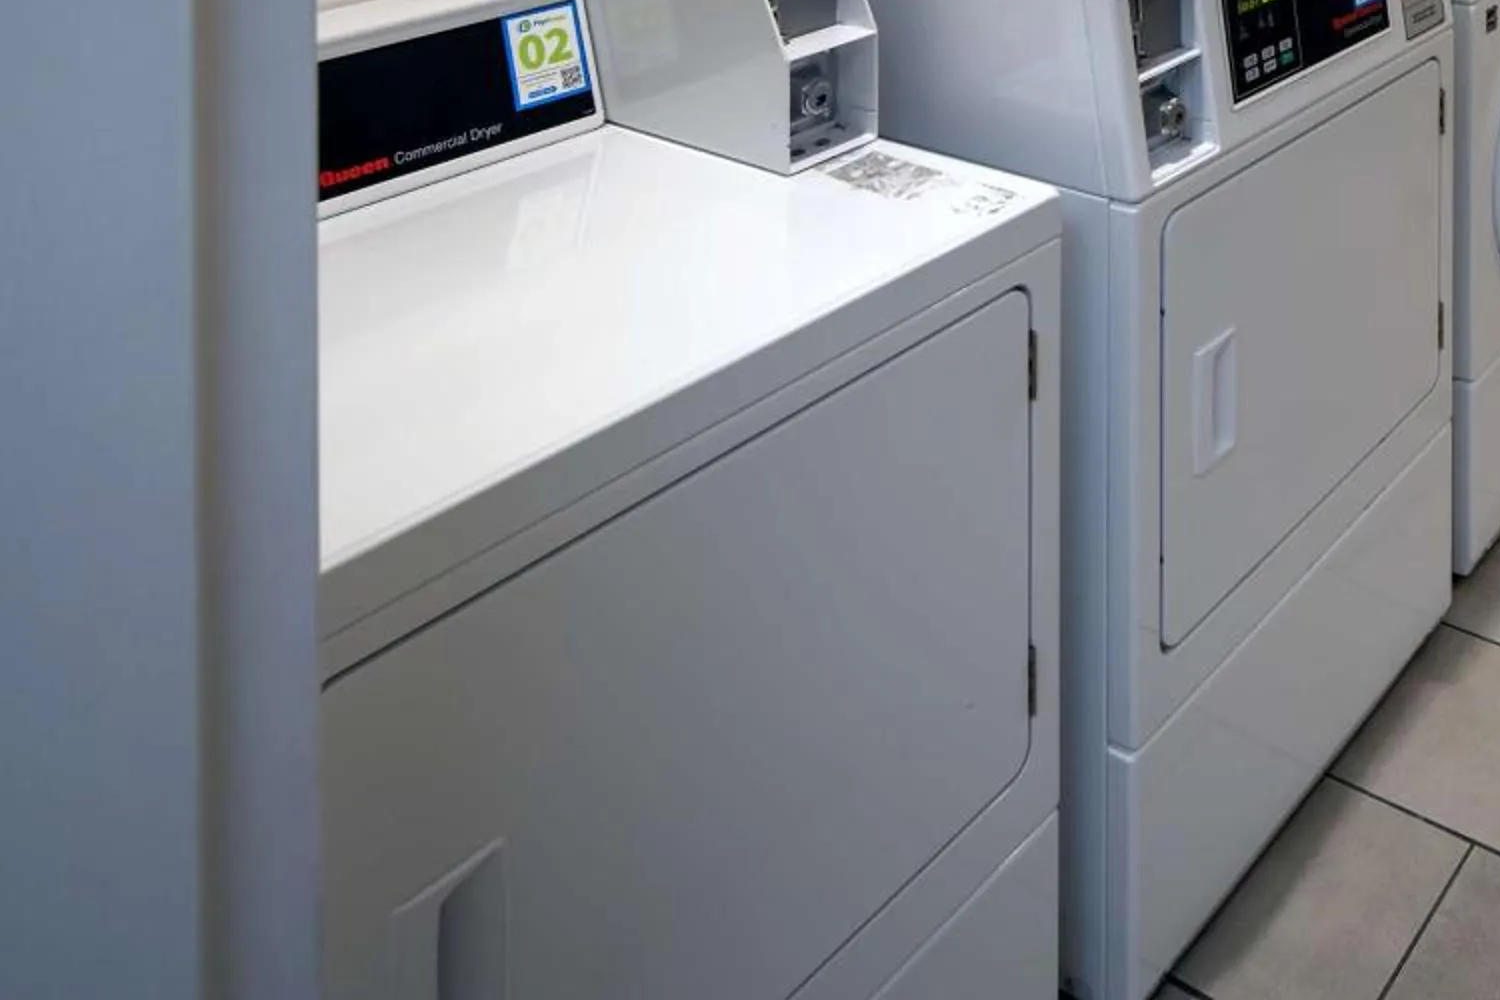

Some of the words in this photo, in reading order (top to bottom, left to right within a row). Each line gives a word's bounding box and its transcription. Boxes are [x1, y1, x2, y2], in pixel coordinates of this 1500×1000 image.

[518, 27, 574, 70] 02
[393, 131, 468, 165] Commercial
[469, 122, 504, 143] Dryer
